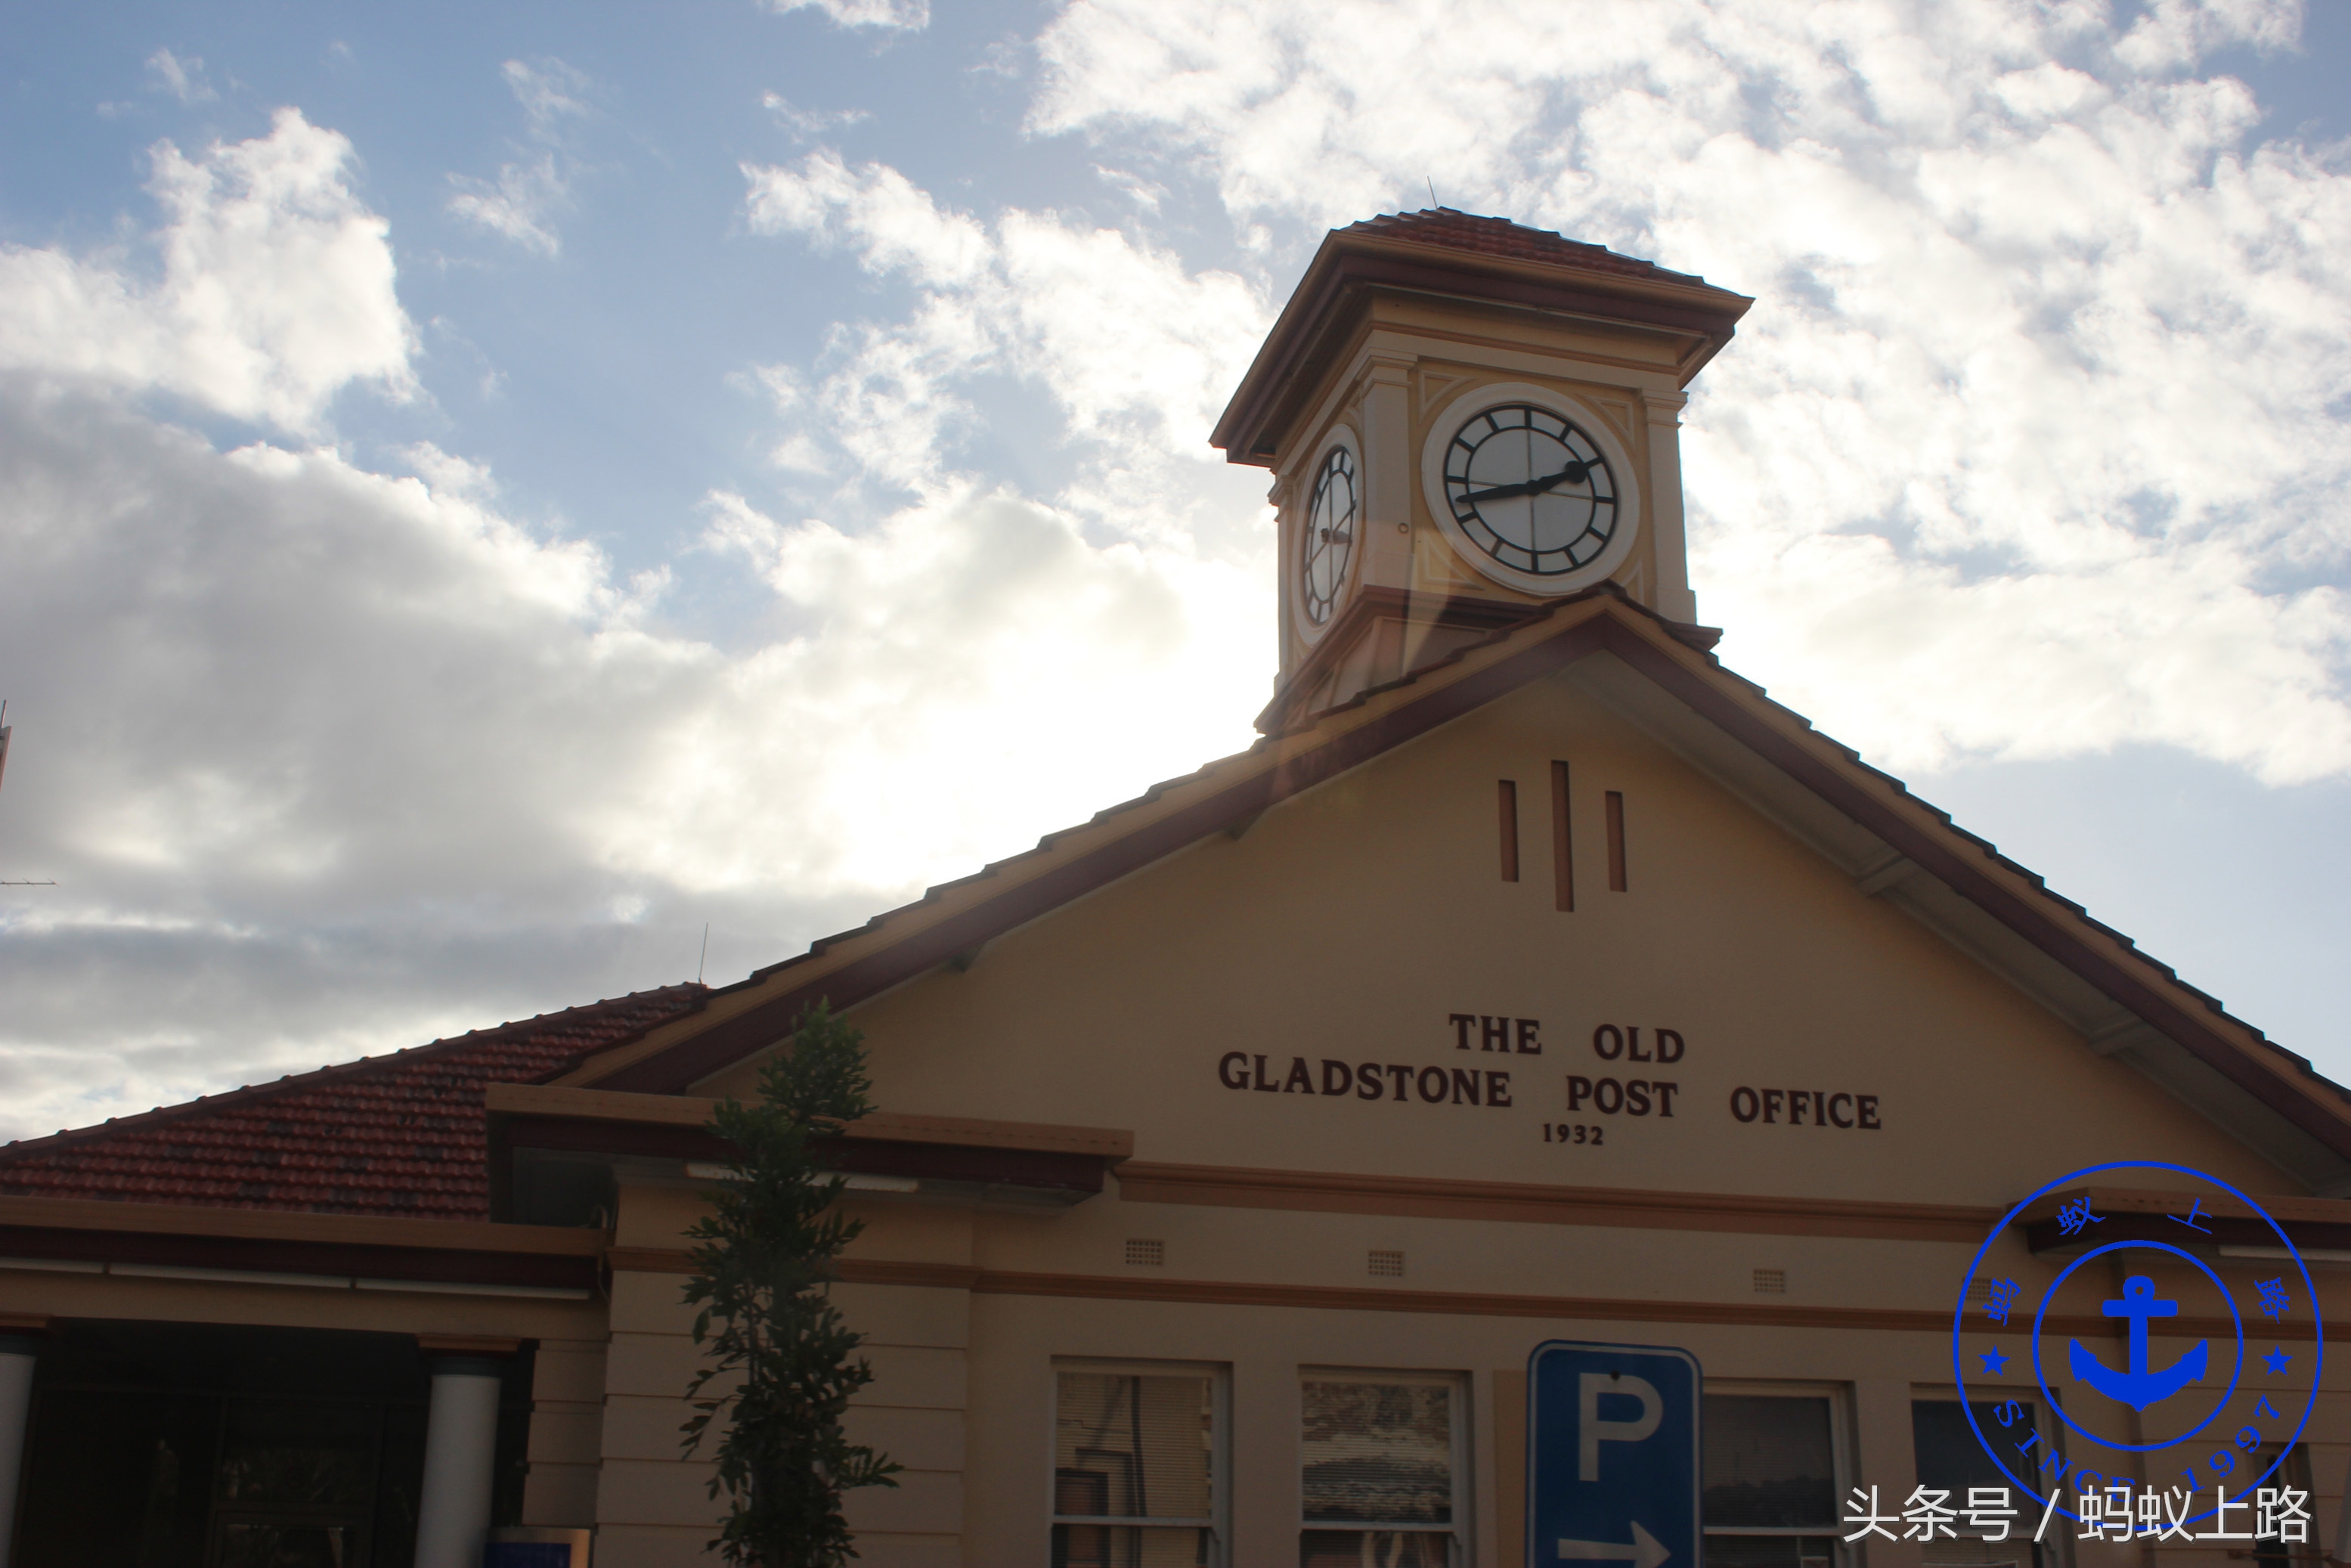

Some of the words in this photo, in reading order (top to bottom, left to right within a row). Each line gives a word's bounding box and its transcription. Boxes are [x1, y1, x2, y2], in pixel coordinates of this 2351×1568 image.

[1448, 1013, 1542, 1055] THE
[1593, 1023, 1685, 1064] OLD
[1218, 1051, 1512, 1108] GLADSTONE
[1566, 1075, 1678, 1118] POST
[1730, 1086, 1882, 1130] OFFICE
[1543, 1123, 1603, 1146] 1932
[1578, 1372, 1663, 1482] P
